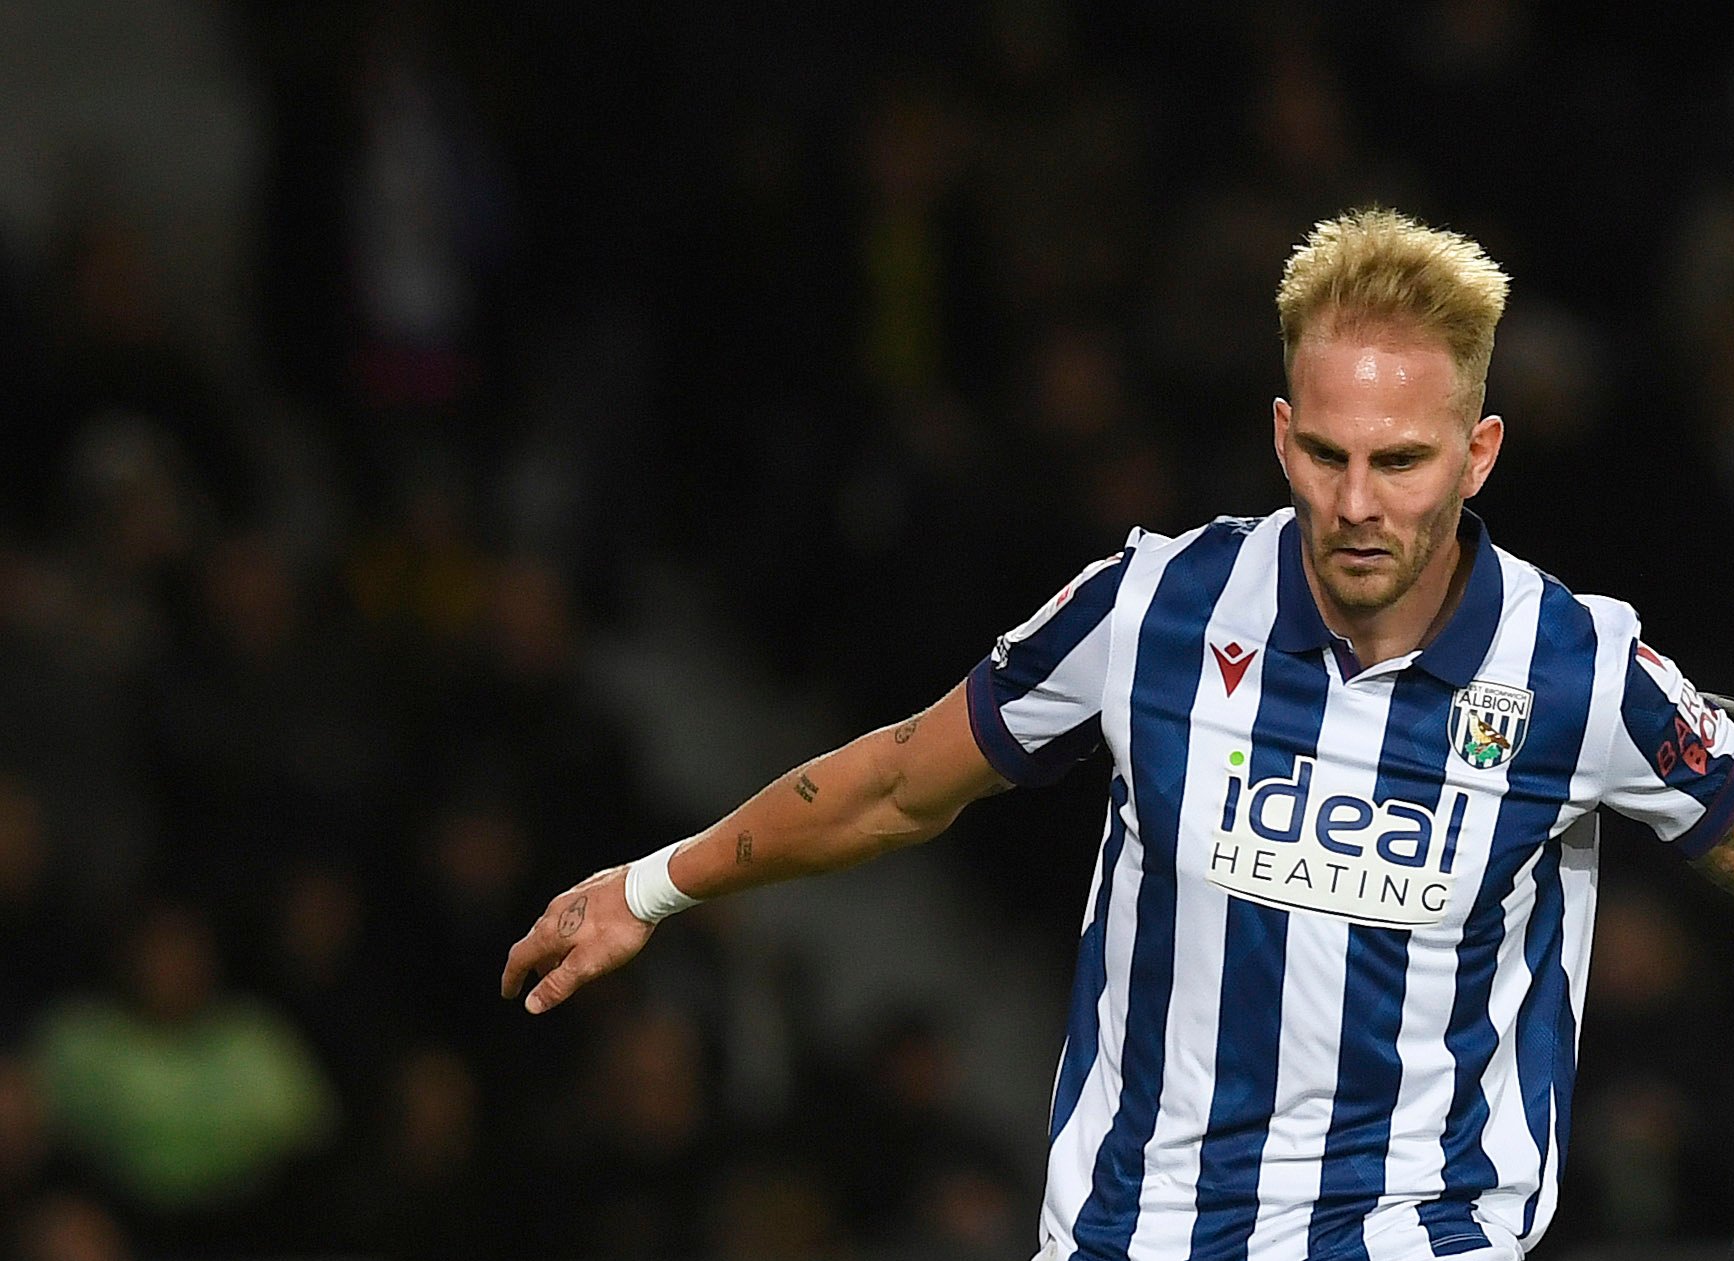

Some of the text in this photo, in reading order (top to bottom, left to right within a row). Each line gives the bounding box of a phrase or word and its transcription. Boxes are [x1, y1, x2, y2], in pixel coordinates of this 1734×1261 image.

[1459, 691, 1526, 715] ALBION
[1221, 751, 1469, 875] ideal
[1211, 842, 1448, 912] HEATING
